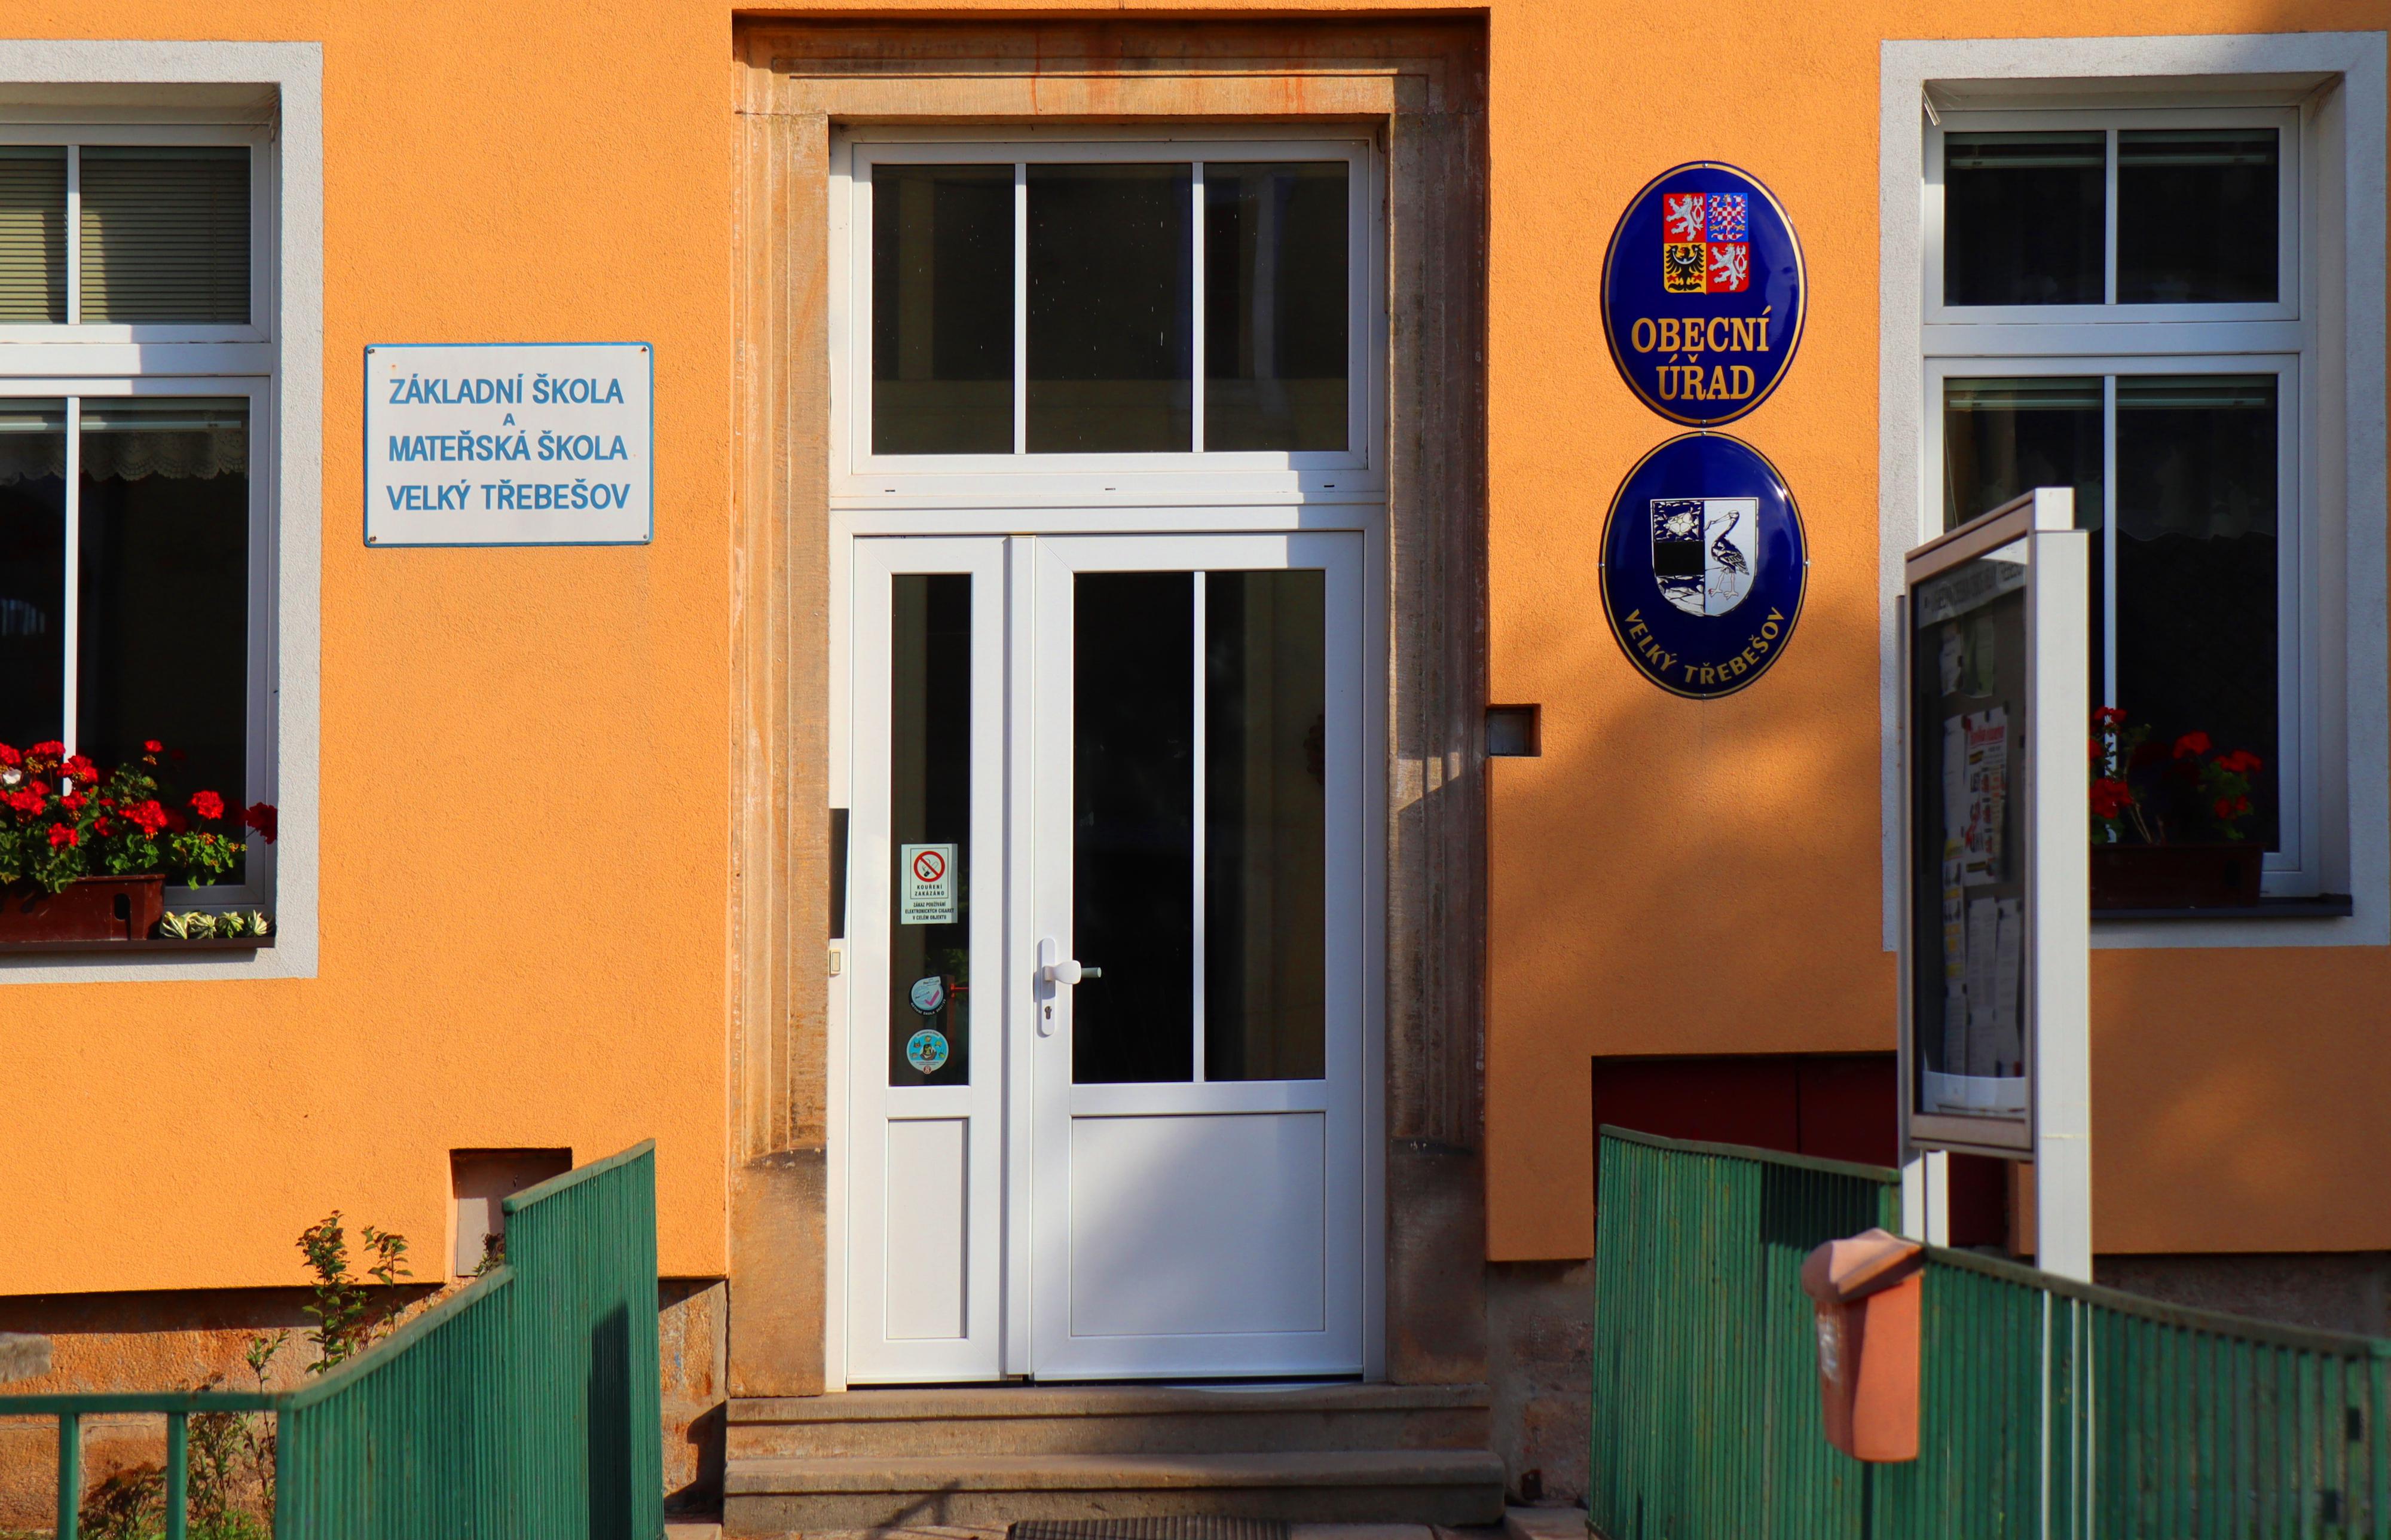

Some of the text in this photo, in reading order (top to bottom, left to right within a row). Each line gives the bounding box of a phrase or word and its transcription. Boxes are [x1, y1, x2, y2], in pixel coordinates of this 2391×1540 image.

[1631, 305, 1772, 353] OBECNÍ
[389, 373, 625, 404] ZÁKLADNÍ ŠKOLA
[1656, 353, 1755, 400] ÚŘAD
[503, 413, 515, 426] A
[389, 430, 628, 461] MATEŘSKÁ ŠKOLA
[386, 479, 631, 510] VELKÝ TŘEBEŠOV
[1625, 607, 1785, 684] VELKÝ TŘEBEŠOV
